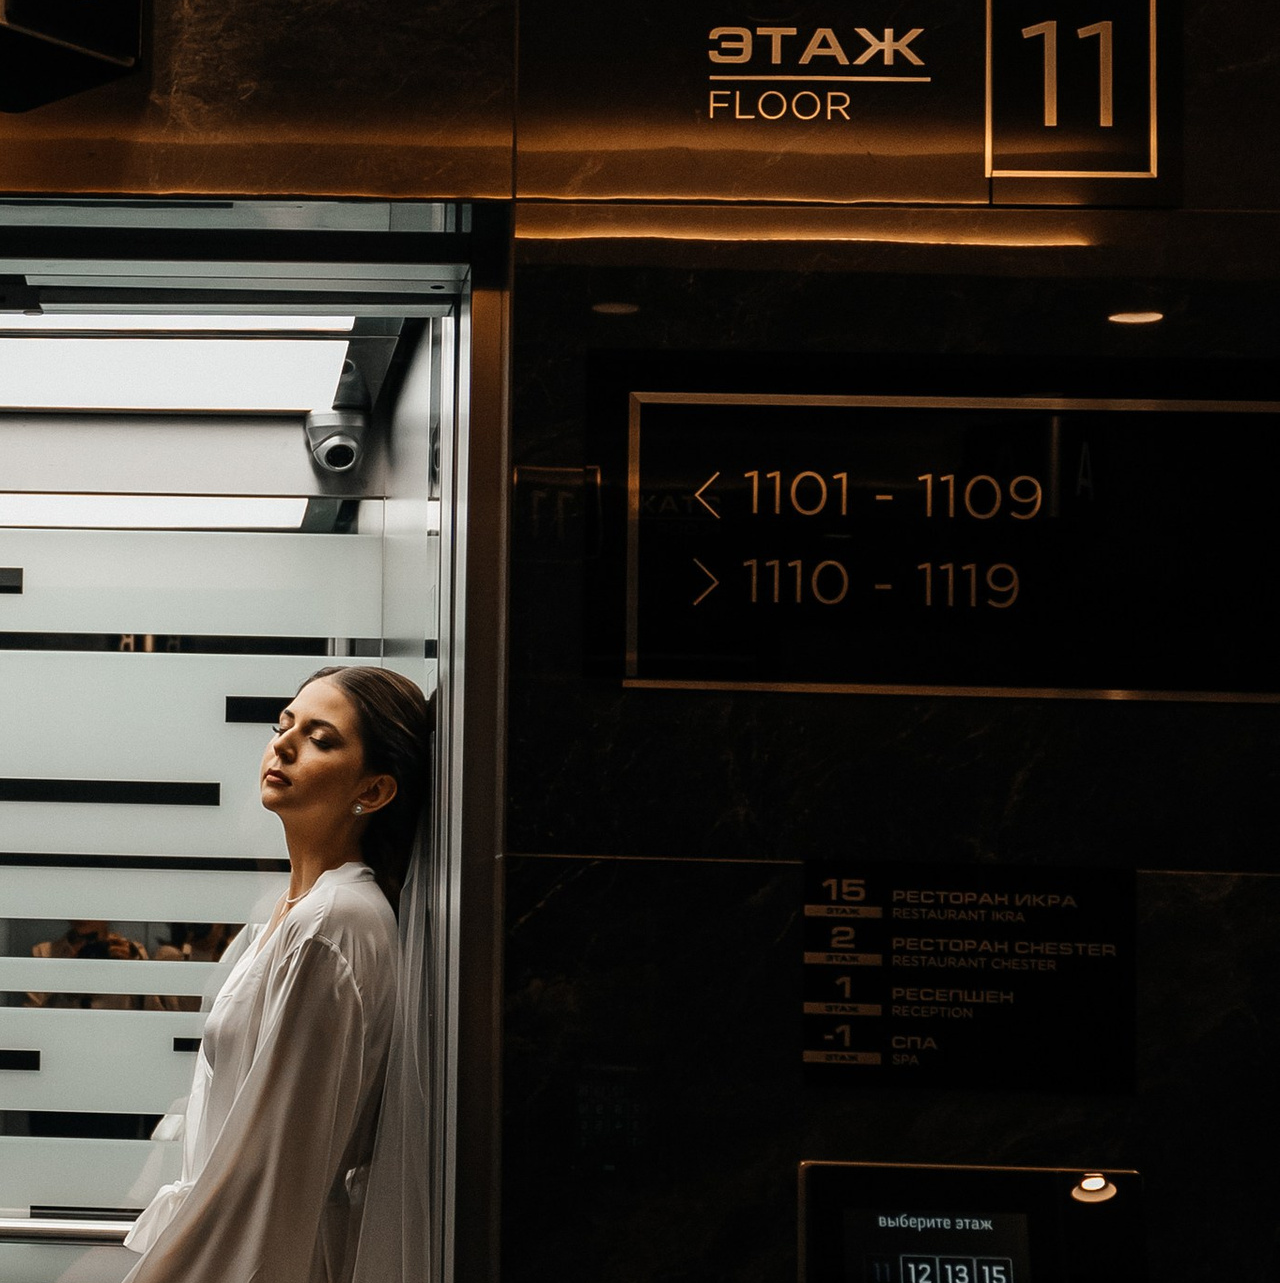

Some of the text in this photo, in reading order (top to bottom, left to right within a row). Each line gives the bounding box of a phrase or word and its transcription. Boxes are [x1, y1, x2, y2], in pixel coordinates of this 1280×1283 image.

[709, 27, 924, 65] ЭТАЖ
[1022, 21, 1113, 127] 11
[710, 91, 850, 120] FLOOR
[745, 471, 847, 515] 1101
[918, 474, 1042, 519] 1109
[744, 559, 848, 604] 1110
[918, 563, 1019, 608] 1119
[823, 879, 865, 901] 15
[893, 891, 1077, 907] РЕСТОРАН ИКРА
[892, 907, 1026, 923] RESTAURANT IKRA
[831, 927, 854, 948] 2
[892, 938, 1115, 956] РЕСТОРАН CHESTER
[892, 955, 1057, 972] RESTAURANT CHESTER
[836, 977, 851, 998] 1
[892, 988, 1013, 1004] РЕСЕПШЕН
[892, 1005, 974, 1019] RECEPTION
[824, 1025, 850, 1046] -1
[892, 1036, 936, 1049] СПА
[892, 1053, 920, 1066] SPA
[878, 1213, 993, 1232] выберите этаж
